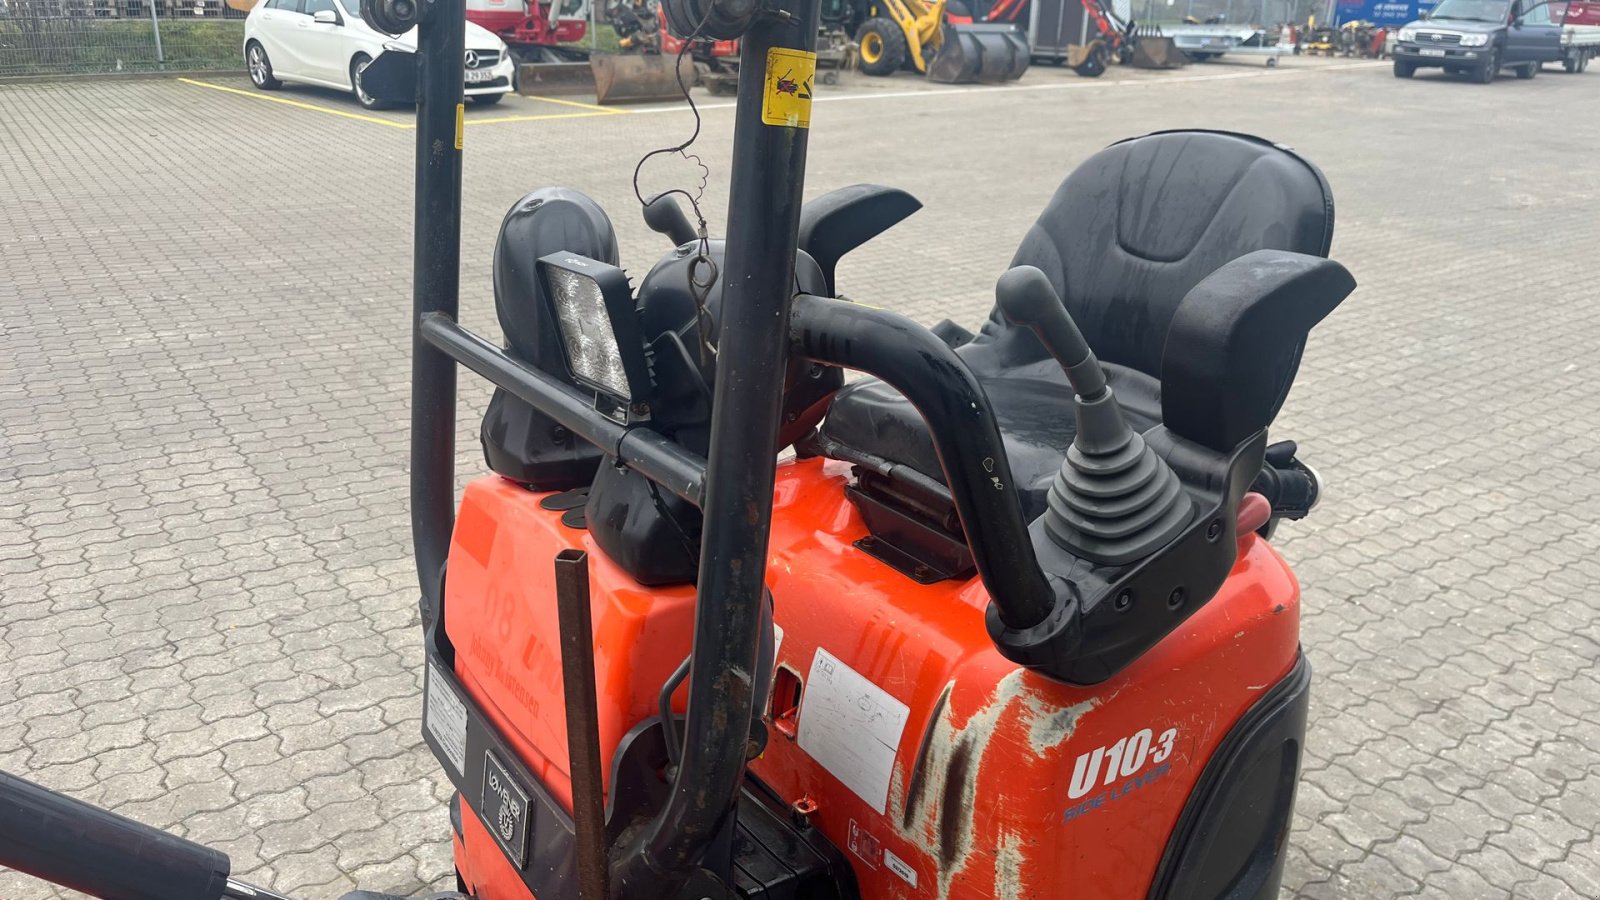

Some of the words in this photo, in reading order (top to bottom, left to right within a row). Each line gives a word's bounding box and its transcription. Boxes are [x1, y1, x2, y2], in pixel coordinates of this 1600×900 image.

[1062, 792, 1108, 823] SIDE
[1109, 762, 1171, 801] LEVER
[1067, 728, 1177, 799] U10-3
